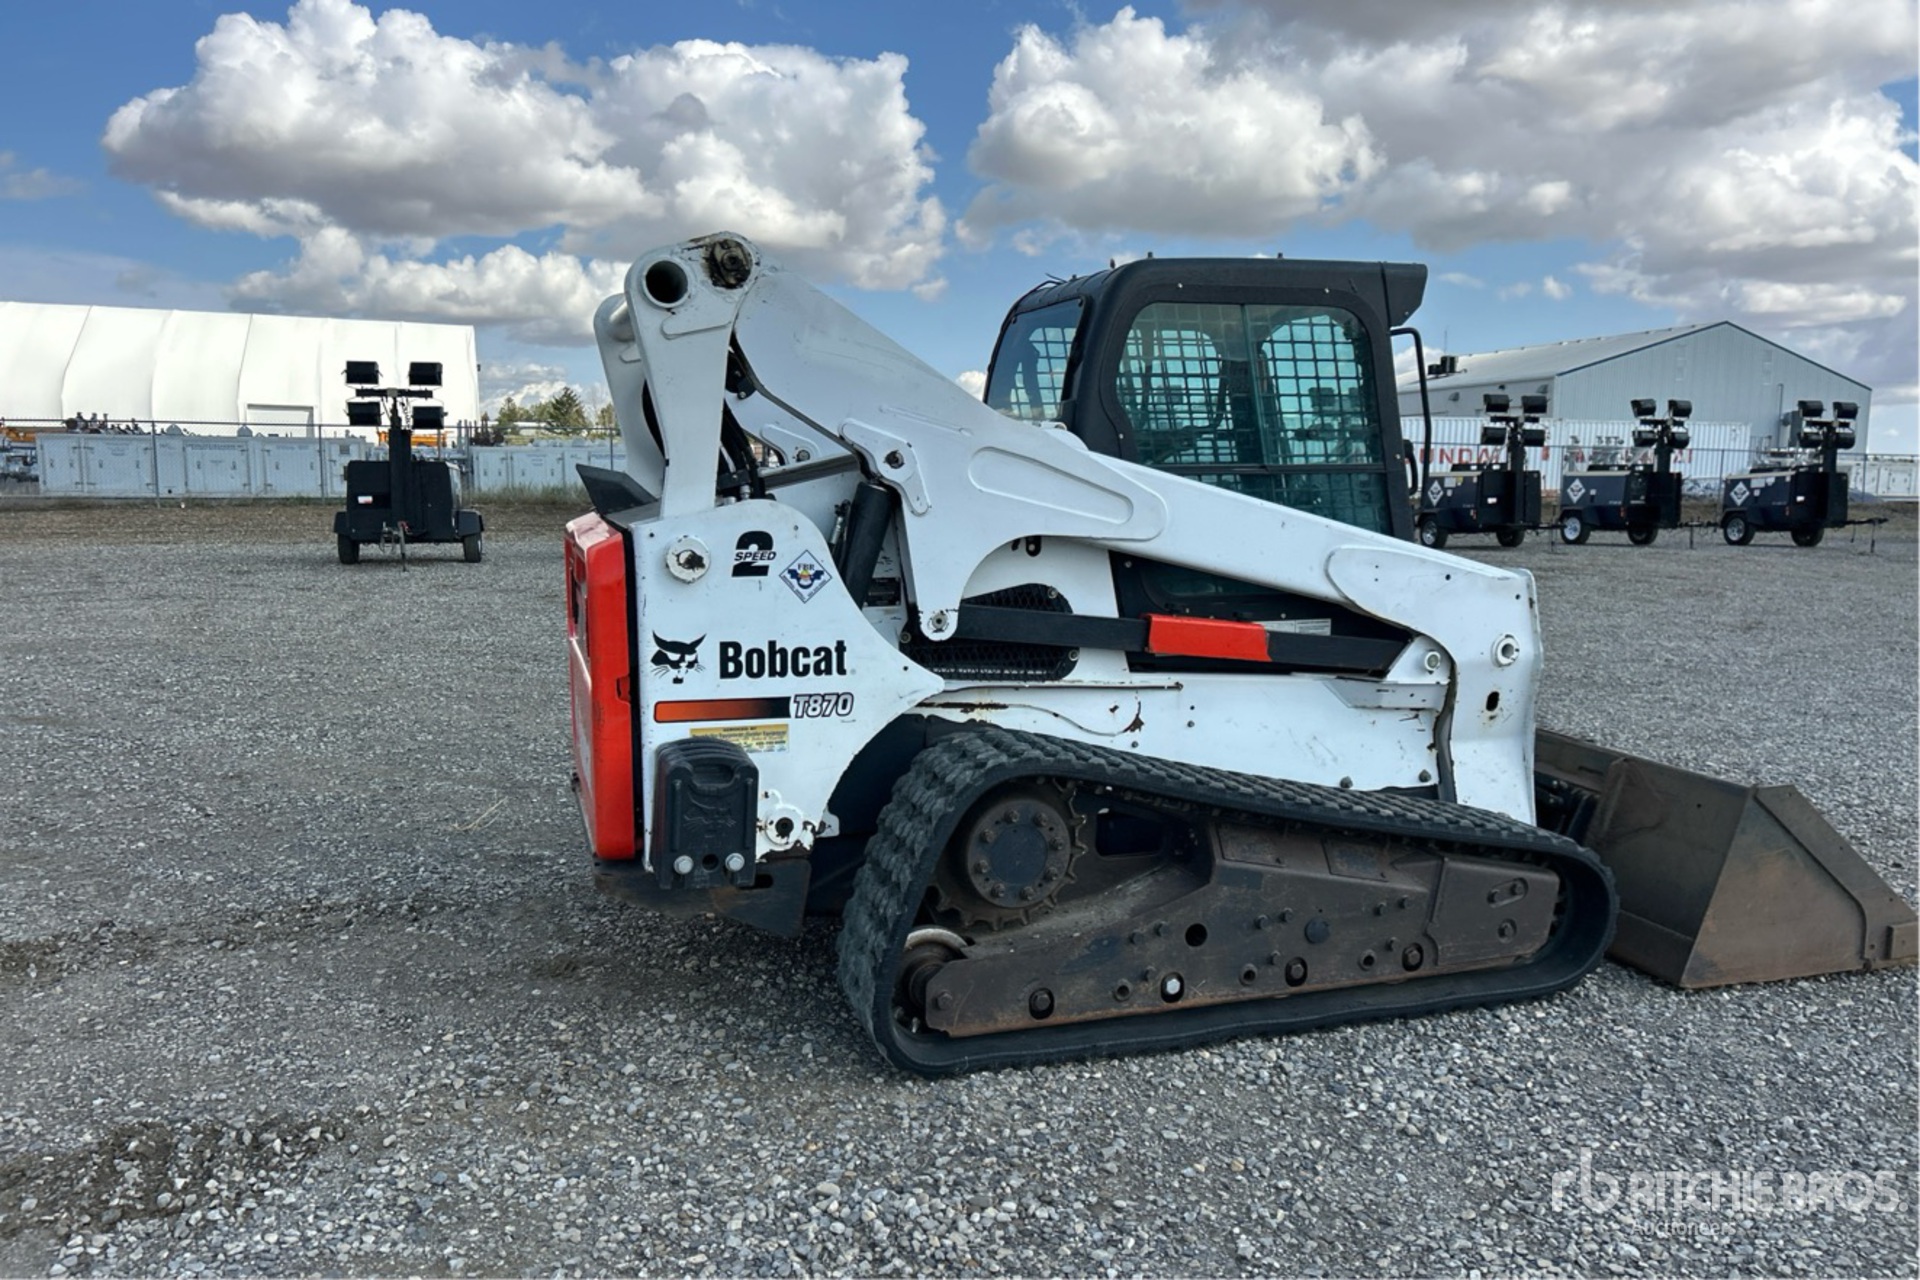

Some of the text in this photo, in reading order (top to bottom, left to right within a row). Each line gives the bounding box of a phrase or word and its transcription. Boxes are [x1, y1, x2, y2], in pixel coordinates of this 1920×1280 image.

[731, 530, 774, 577] 2
[734, 551, 777, 562] SPEED
[719, 640, 847, 679] Bobcat
[793, 692, 854, 719] T870
